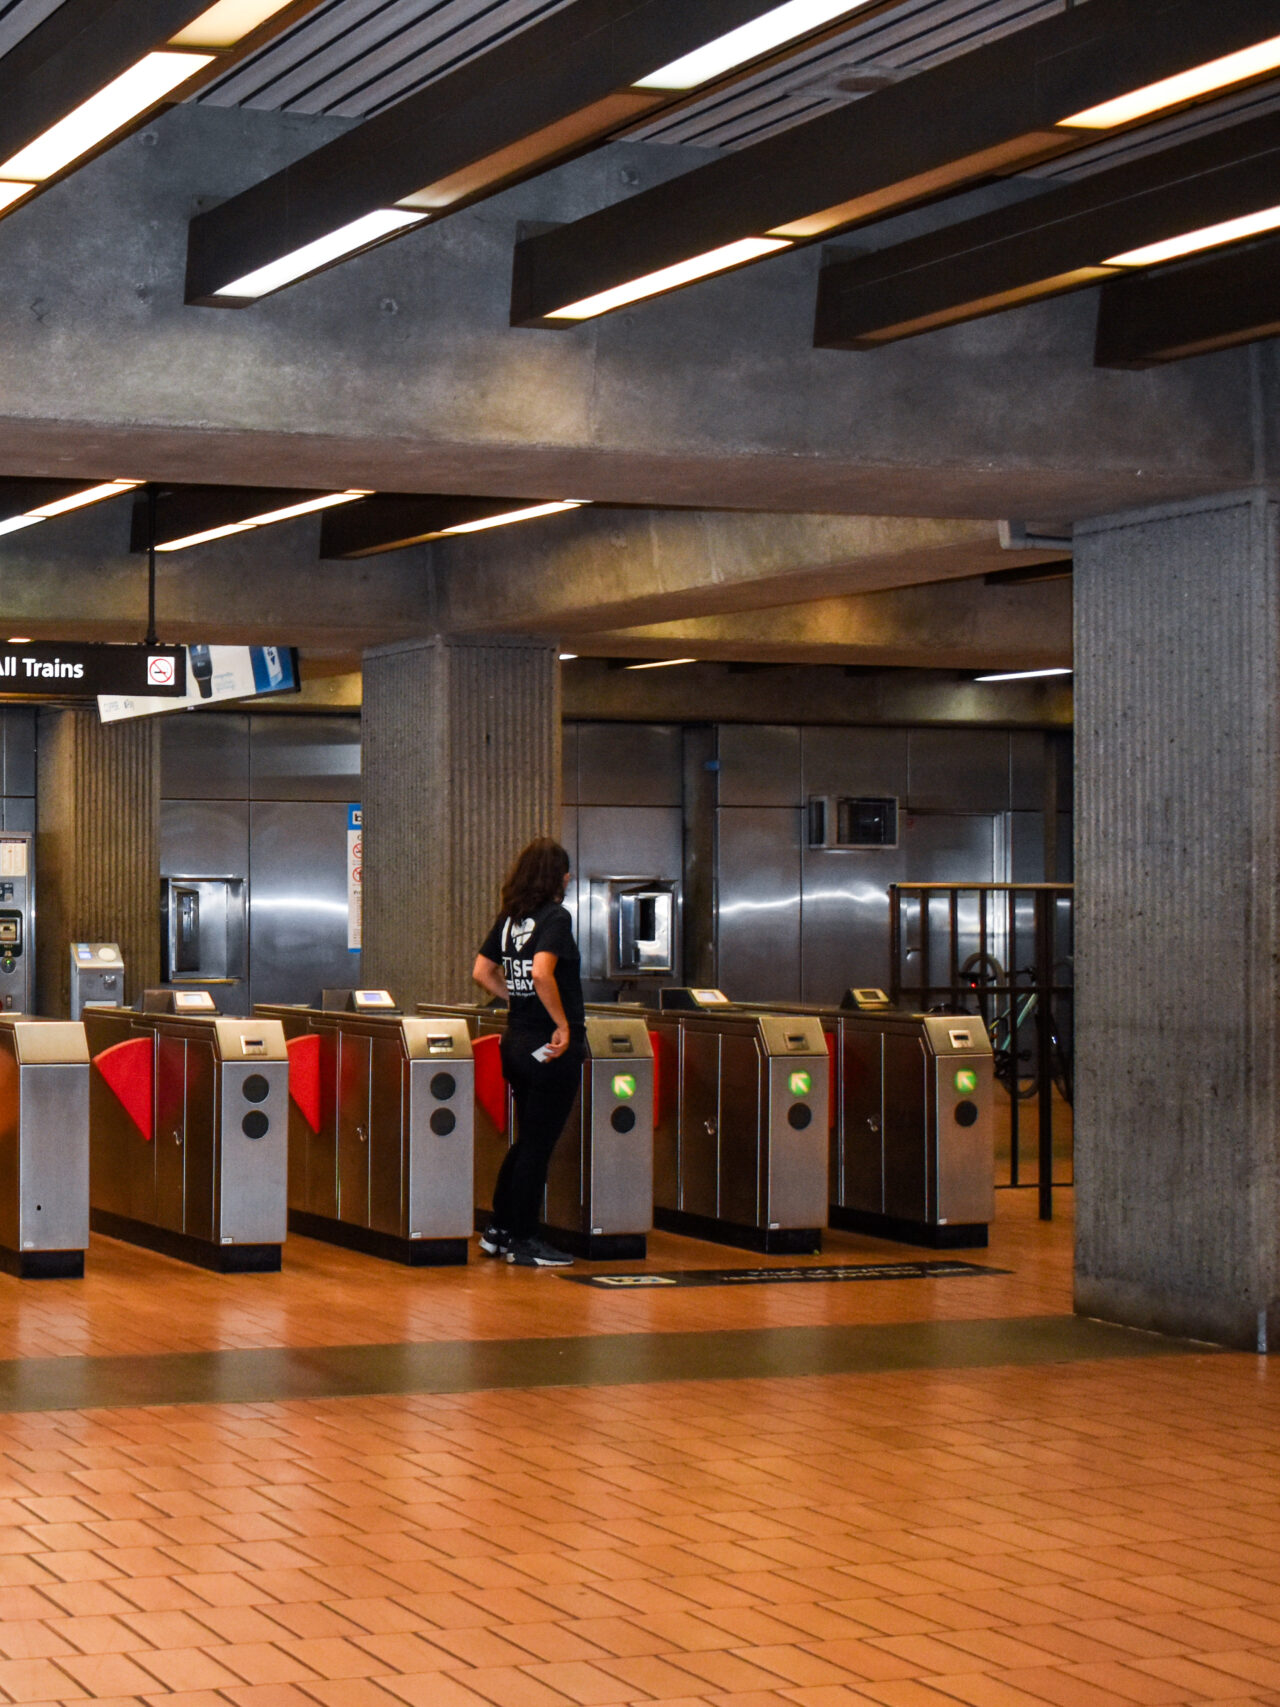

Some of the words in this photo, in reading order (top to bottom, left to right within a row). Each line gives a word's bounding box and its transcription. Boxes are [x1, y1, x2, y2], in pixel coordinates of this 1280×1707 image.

[22, 658, 84, 679] Trains
[513, 959, 533, 977] SF
[515, 979, 534, 990] BAY
